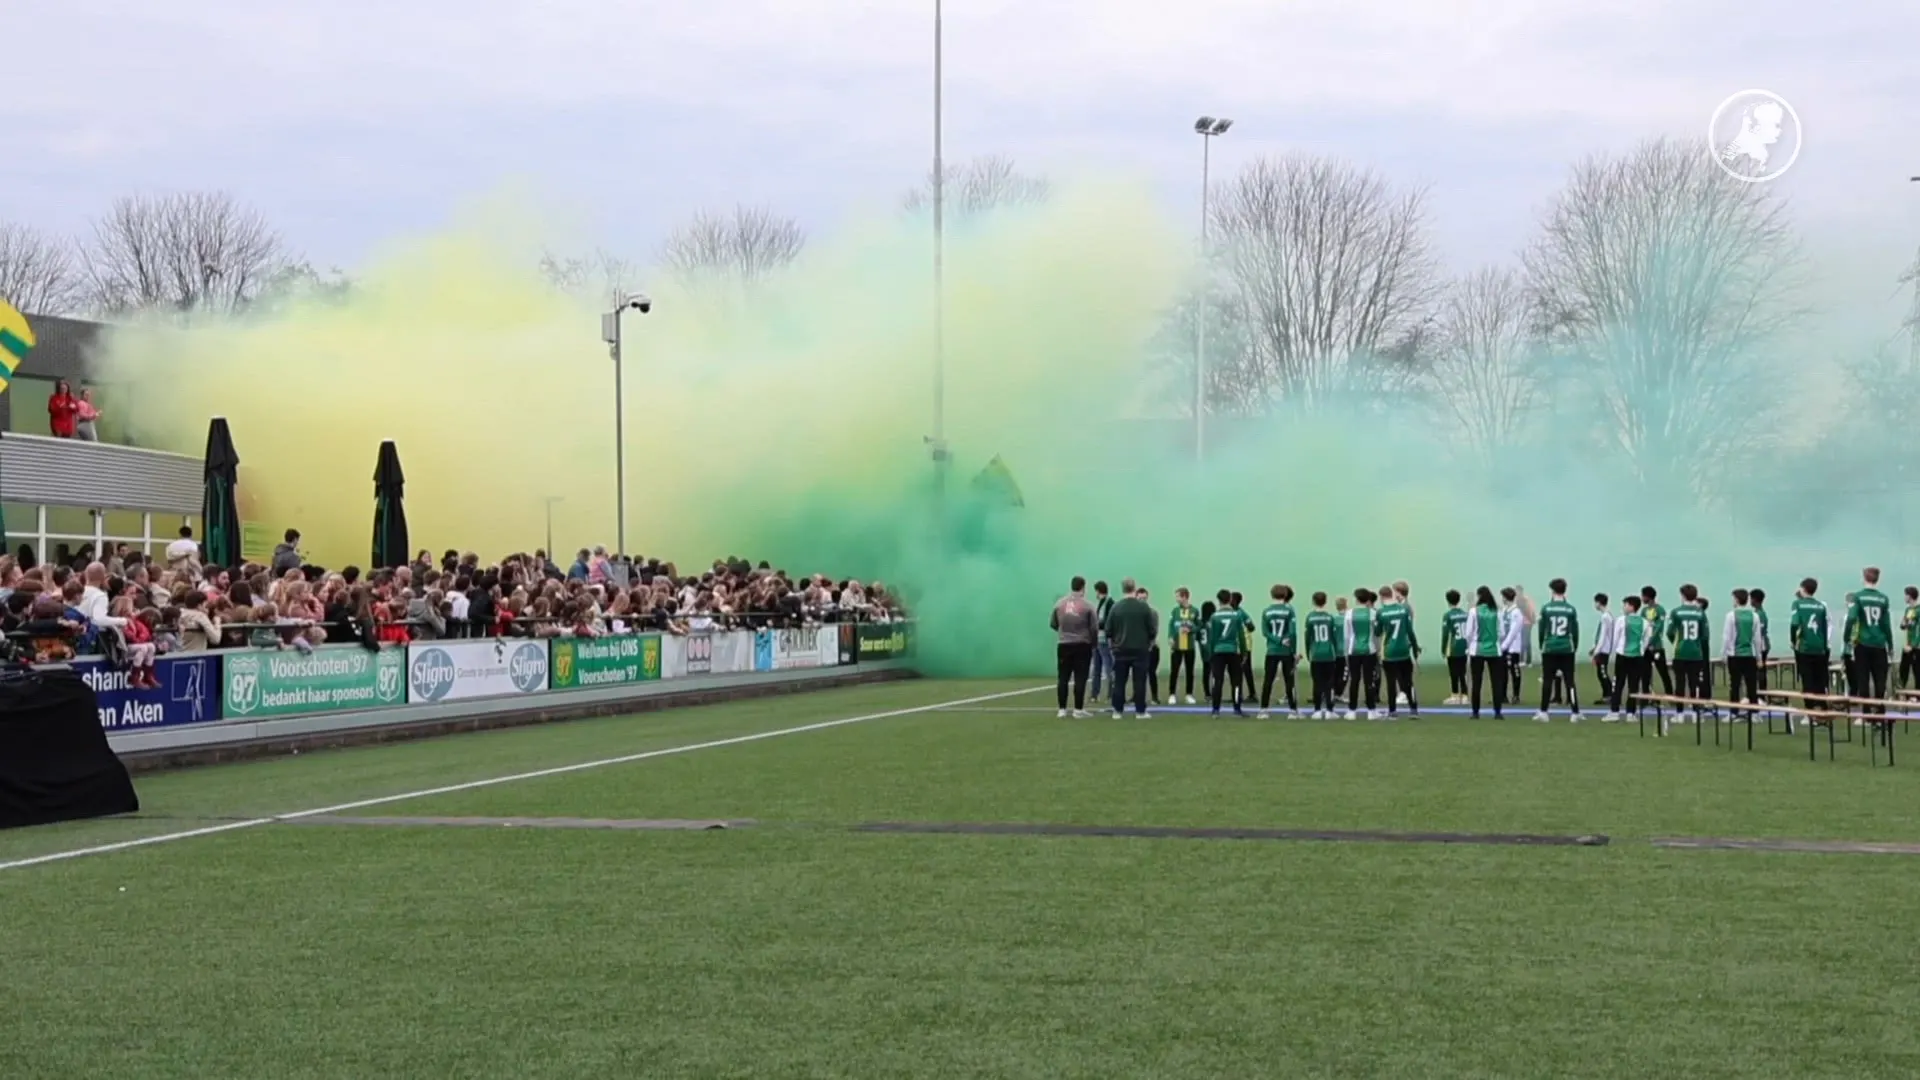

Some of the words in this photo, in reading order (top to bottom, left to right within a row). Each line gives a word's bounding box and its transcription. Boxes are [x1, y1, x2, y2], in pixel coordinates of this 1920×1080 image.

[1222, 619, 1232, 637] 7
[1270, 619, 1285, 637] 17
[1313, 624, 1329, 642] 10
[1390, 620, 1401, 639] 7
[1549, 616, 1568, 636] 12
[1681, 620, 1699, 640] 13
[1807, 614, 1819, 634] 4
[577, 642, 608, 660] Welkom
[610, 640, 620, 661] bij
[621, 639, 638, 657] ONS
[270, 656, 348, 679] Voorschoten
[350, 654, 368, 674] '97
[413, 652, 453, 697] Sligro
[511, 647, 545, 688] Sligro
[578, 666, 625, 684] Voorschoten
[232, 674, 257, 702] 97
[379, 667, 399, 691] 97
[262, 687, 306, 707] bedankt
[308, 686, 331, 703] haar
[332, 686, 374, 706] sponsors
[98, 706, 117, 727] an
[121, 700, 163, 725] Aken
